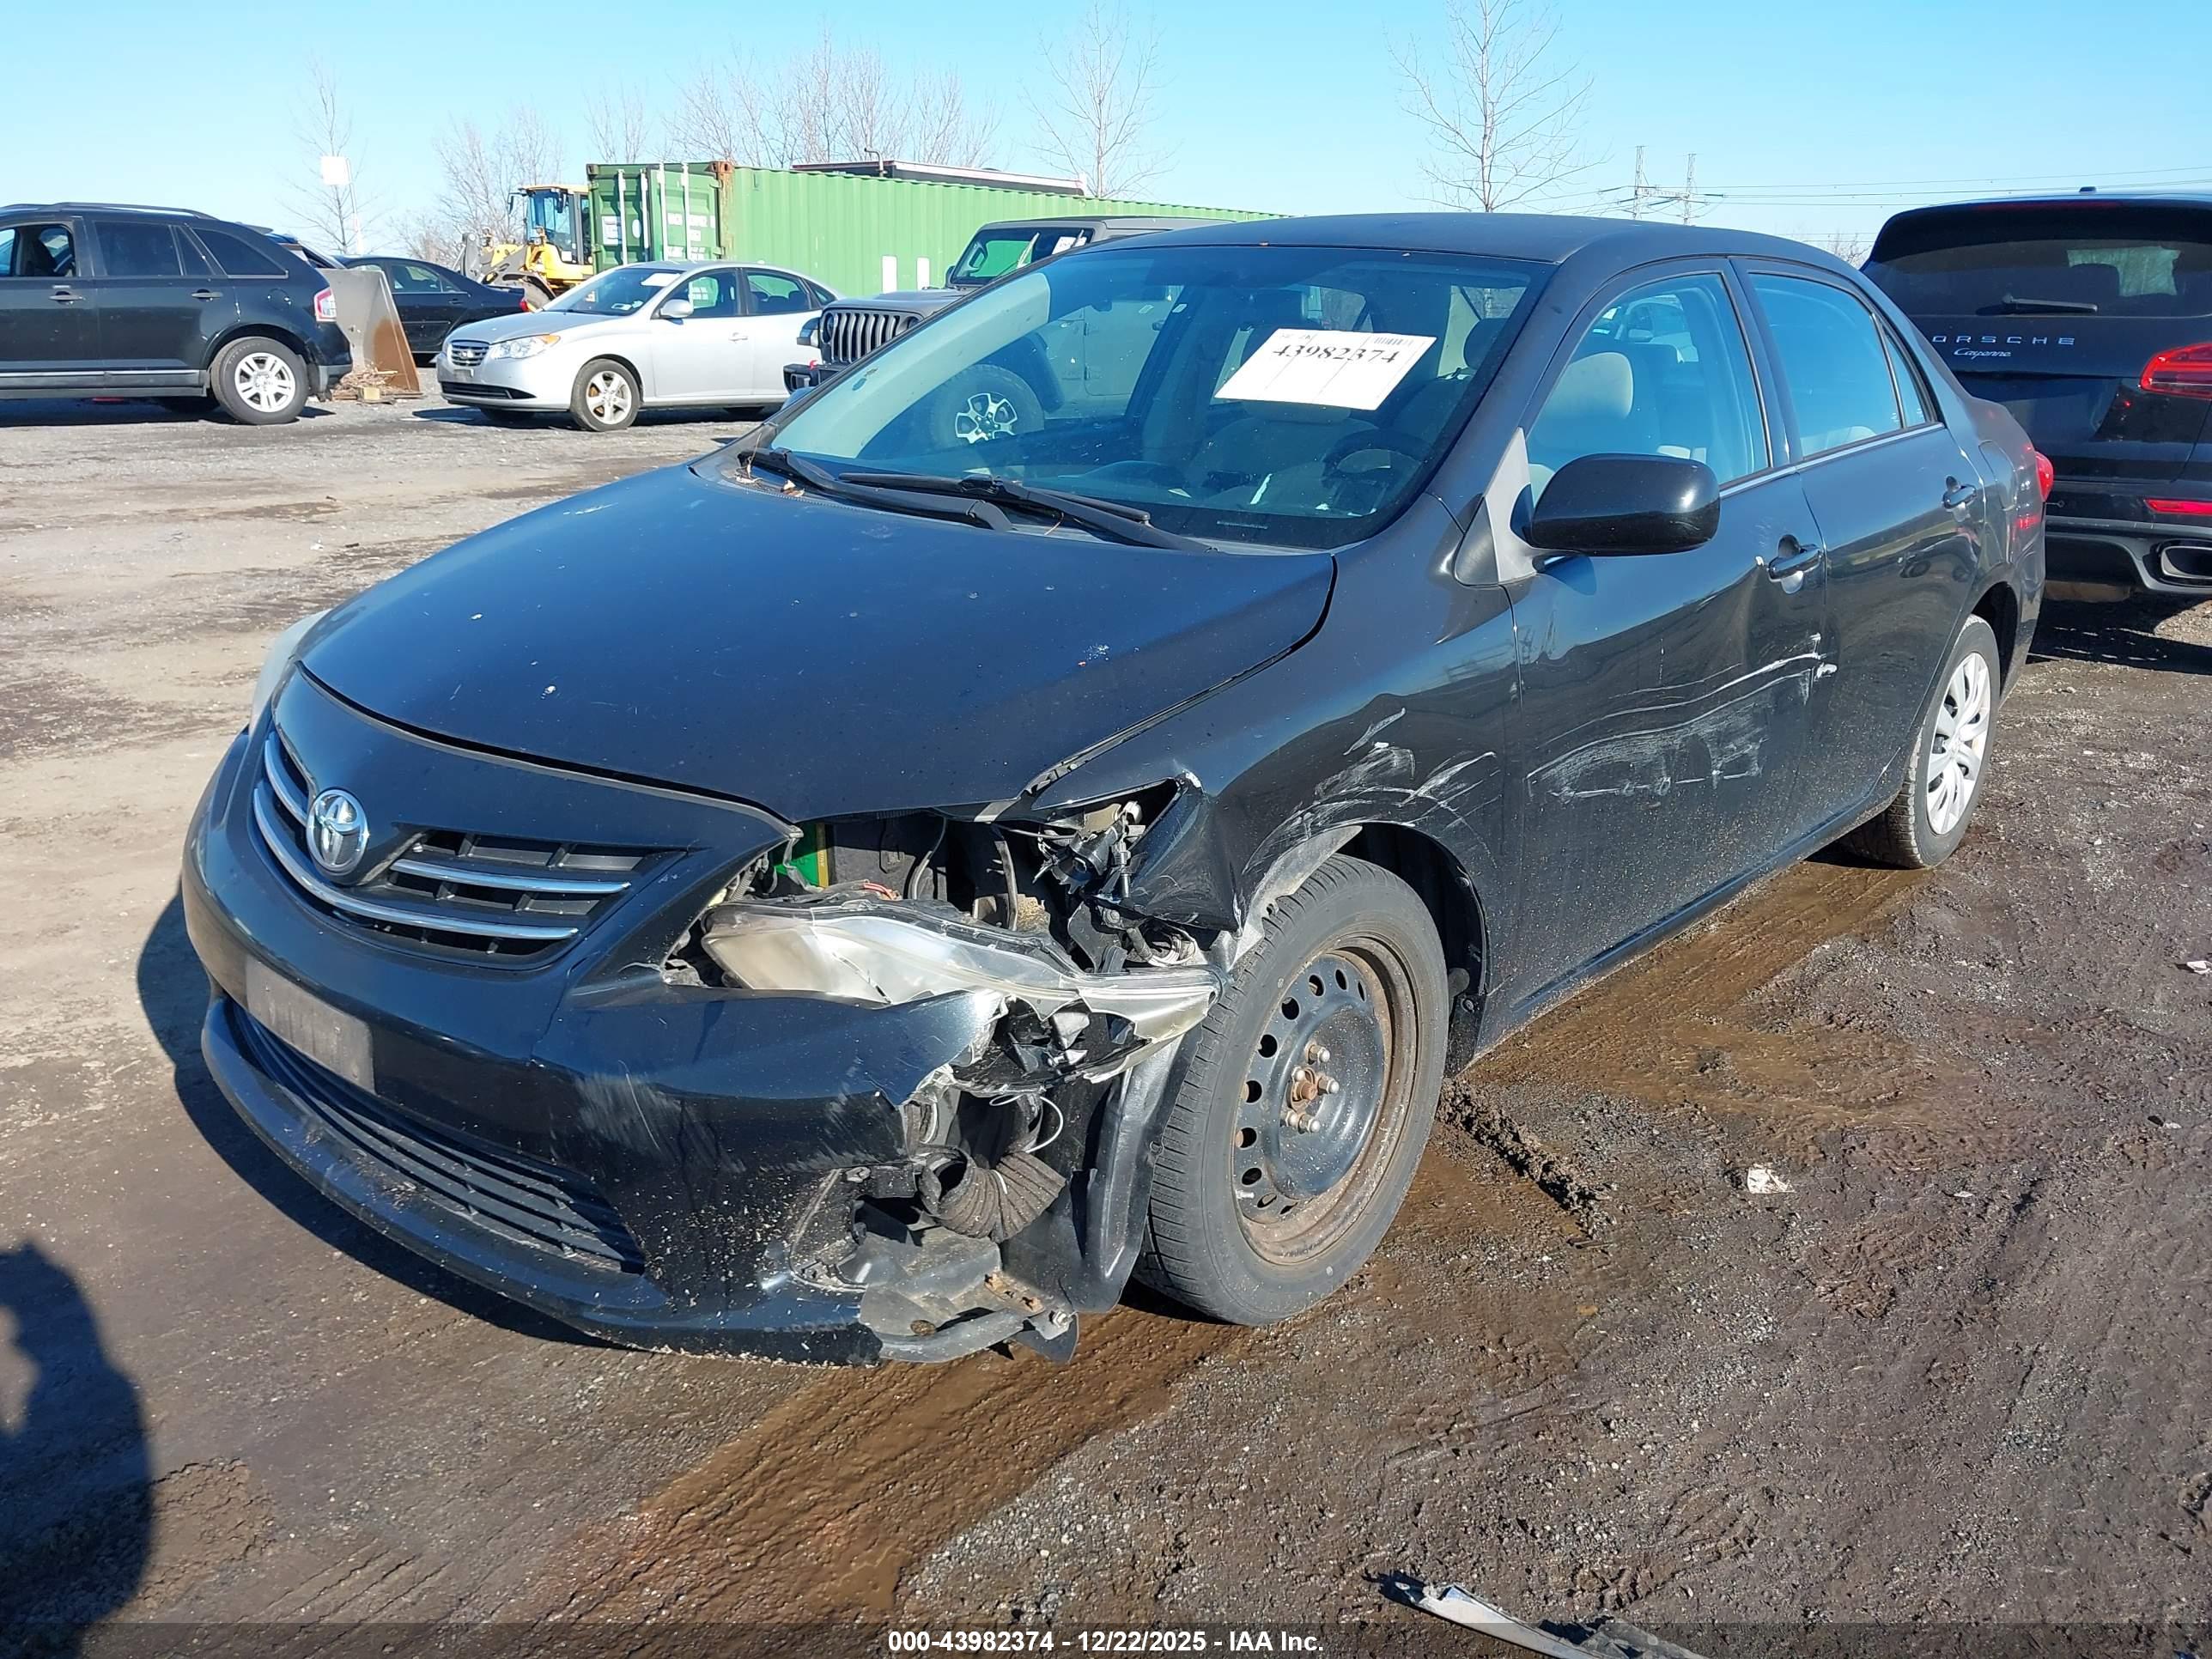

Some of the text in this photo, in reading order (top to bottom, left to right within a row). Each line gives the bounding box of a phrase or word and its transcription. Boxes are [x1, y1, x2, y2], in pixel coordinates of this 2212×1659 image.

[1932, 335, 2075, 345] ORSCHE
[1273, 344, 1400, 363] 43982374
[1954, 347, 2012, 360] Cayenne
